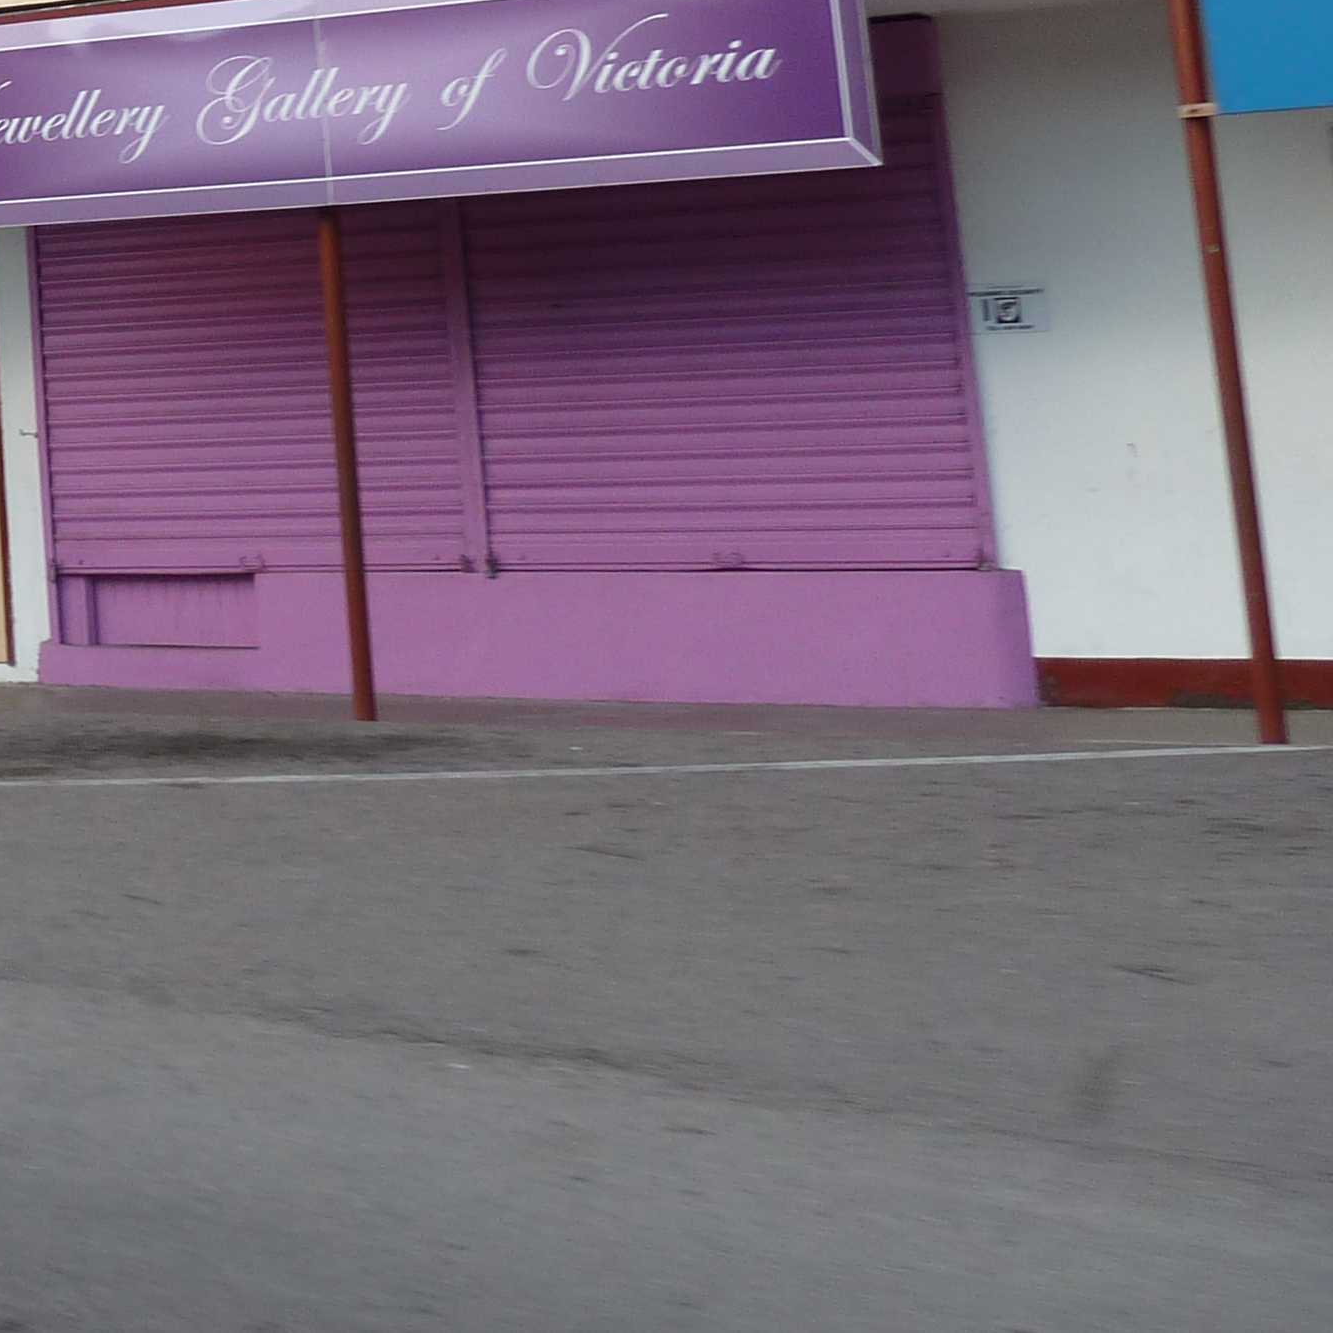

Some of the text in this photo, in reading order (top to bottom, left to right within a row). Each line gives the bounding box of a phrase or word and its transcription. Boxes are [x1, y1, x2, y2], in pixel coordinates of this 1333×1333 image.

[196, 55, 410, 146] Gallery
[436, 47, 507, 131] of
[527, 13, 782, 102] Victoria
